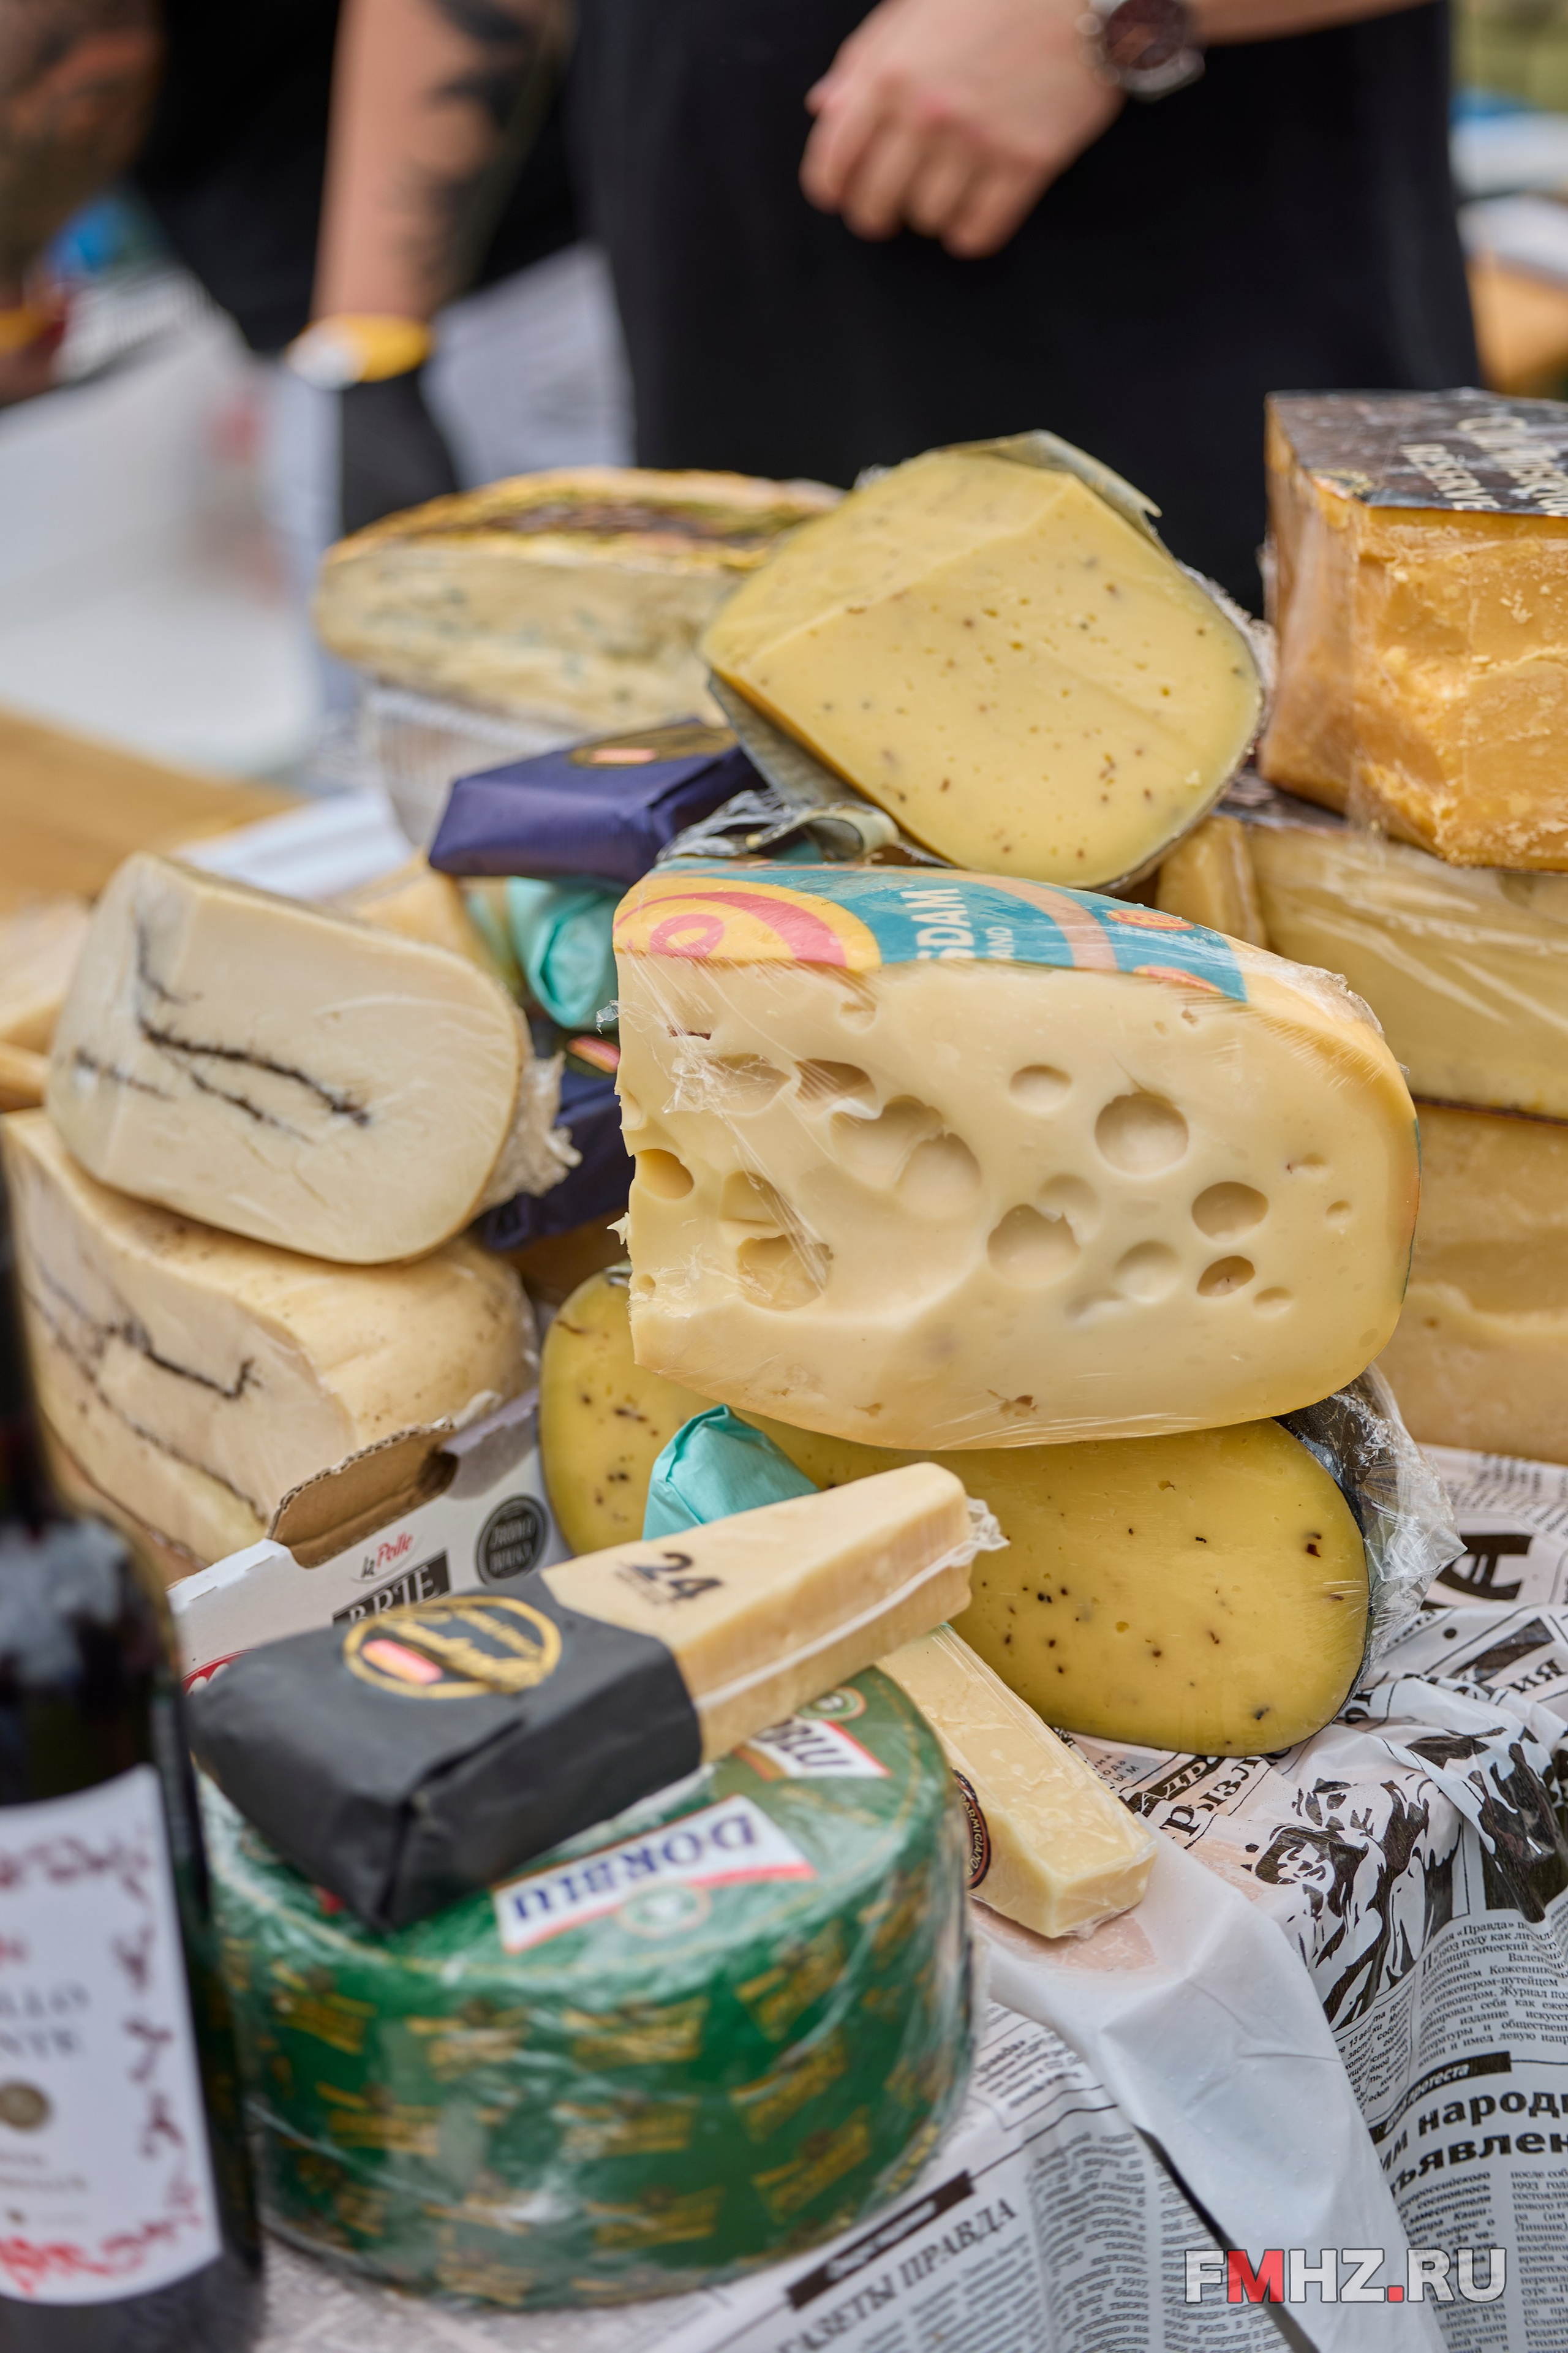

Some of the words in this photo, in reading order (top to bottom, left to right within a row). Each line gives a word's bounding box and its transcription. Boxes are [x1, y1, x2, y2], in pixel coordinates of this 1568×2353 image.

[631, 1550, 723, 1601] 24
[513, 1813, 756, 1921] DORBLU
[1390, 2131, 1568, 2198] ъявлен
[898, 2198, 1019, 2290] ПРАВДА
